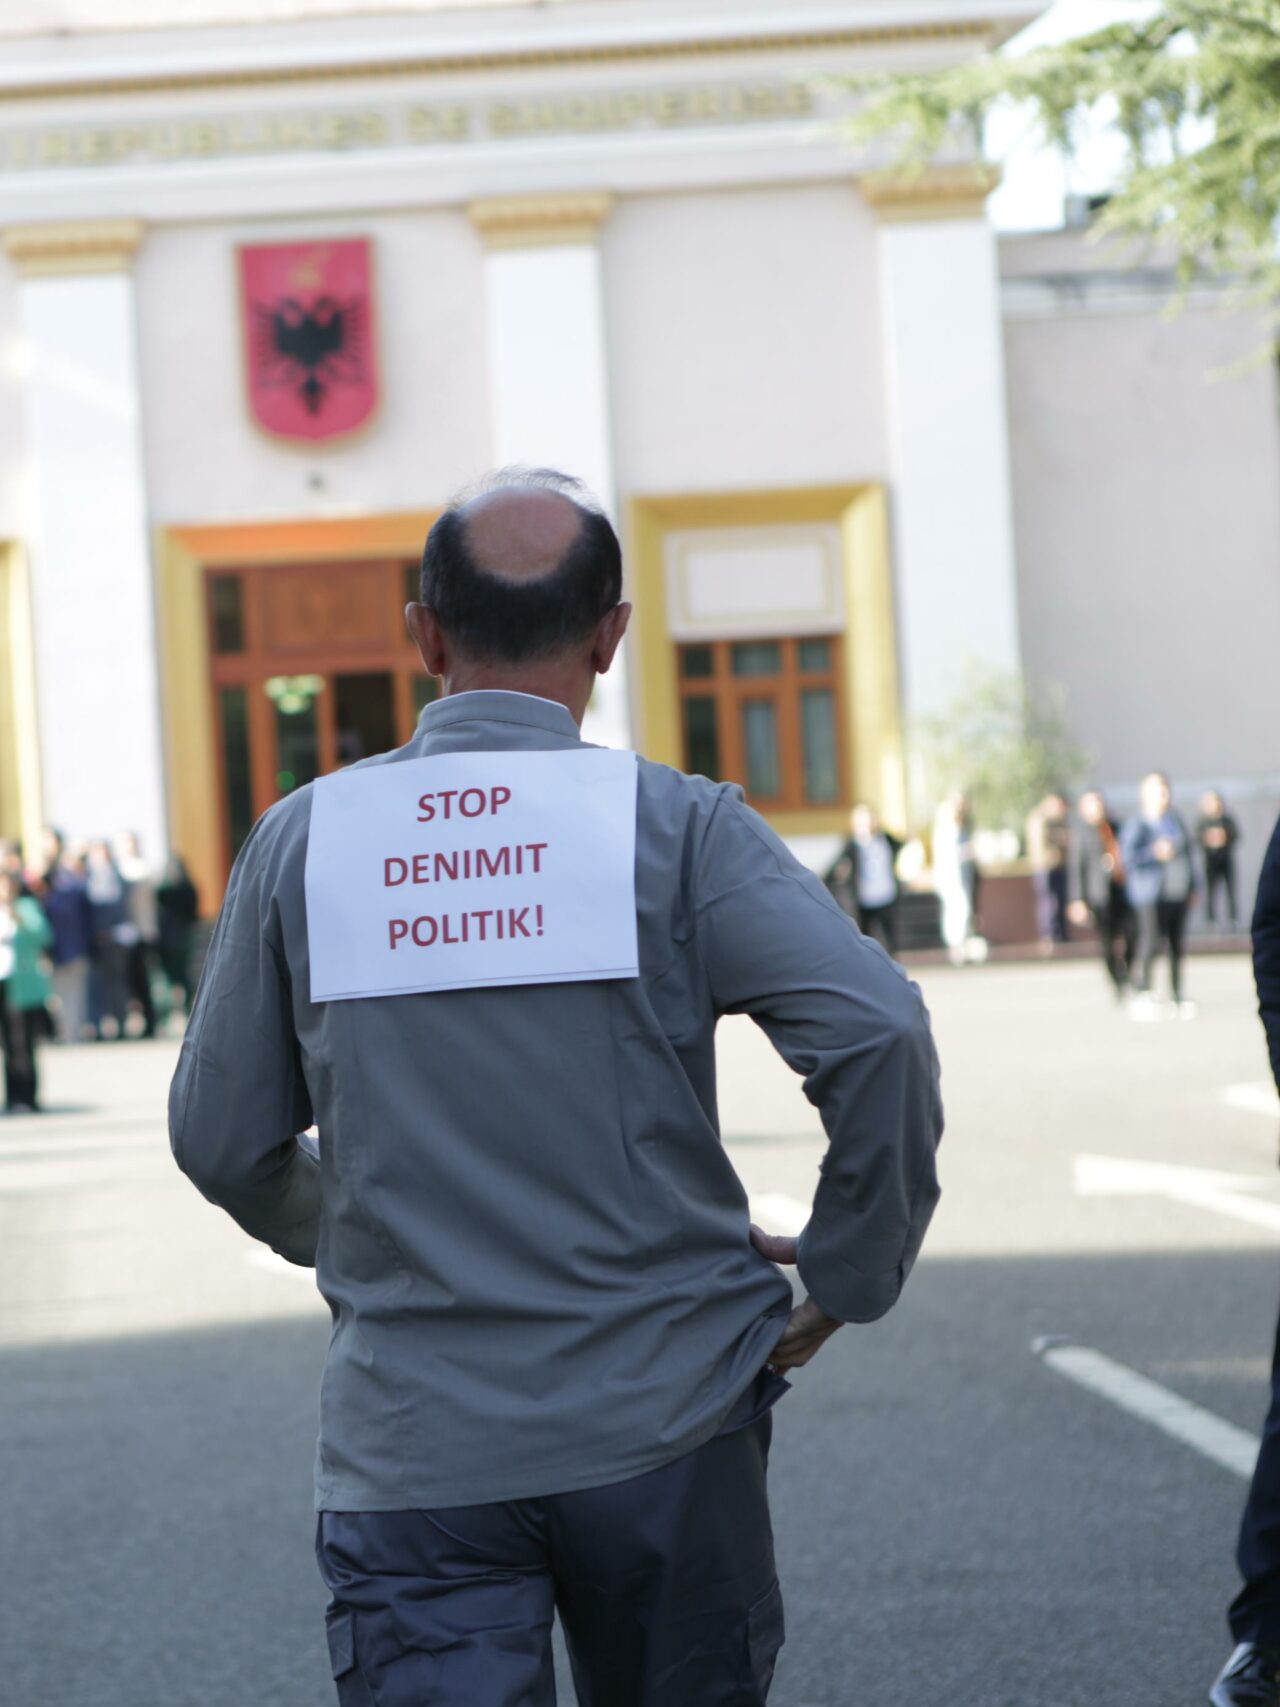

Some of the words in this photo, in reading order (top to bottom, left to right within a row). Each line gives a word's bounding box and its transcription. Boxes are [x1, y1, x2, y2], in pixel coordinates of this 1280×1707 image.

[416, 786, 511, 823] STOP
[383, 843, 548, 887] DENIMIT
[388, 904, 544, 950] POLITIK!
